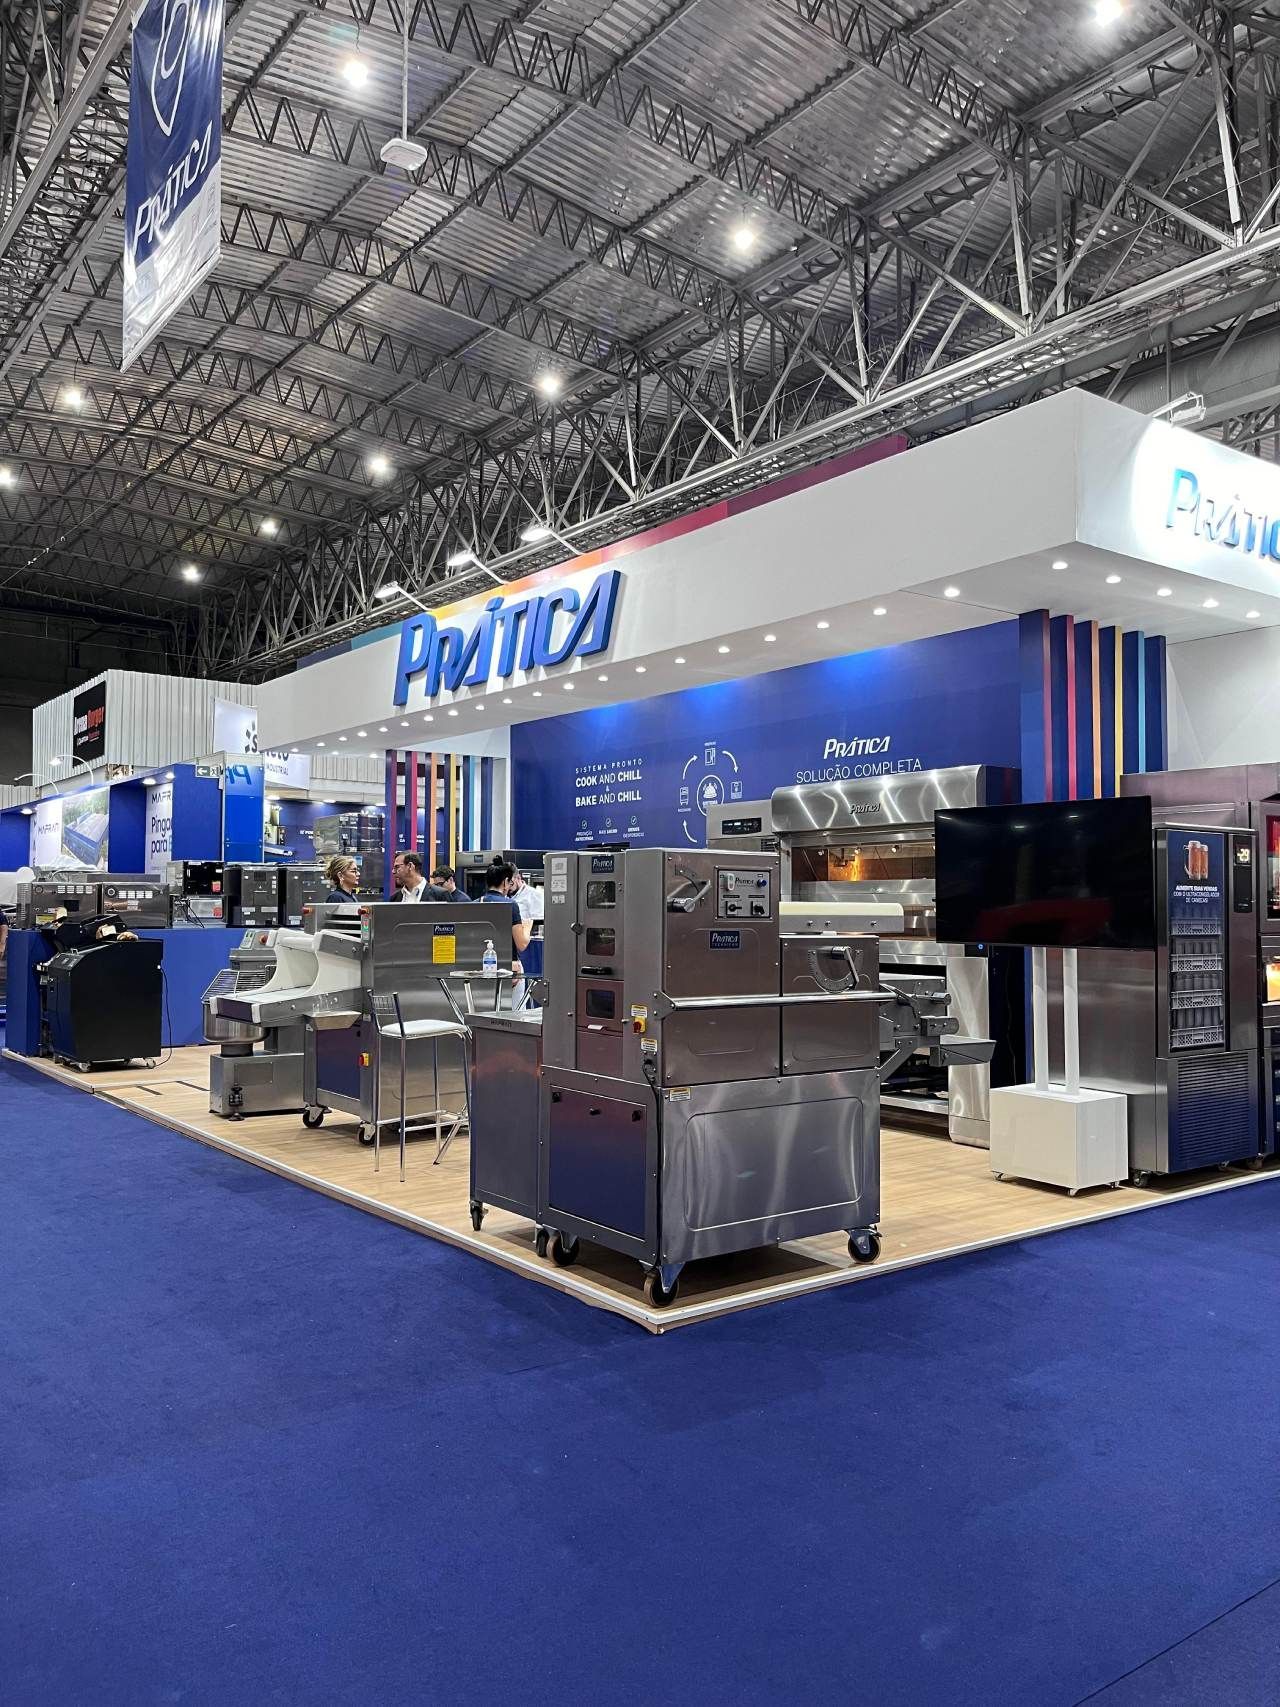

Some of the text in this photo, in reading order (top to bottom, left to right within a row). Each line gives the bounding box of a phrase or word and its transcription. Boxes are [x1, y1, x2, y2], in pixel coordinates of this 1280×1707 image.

[393, 570, 622, 706] PRÁTICA
[823, 736, 890, 759] PRÁTICA
[575, 763, 607, 774] SISTEMA
[575, 769, 642, 787] COOK AND CHILL
[796, 758, 922, 784] SOLUÇÃO COMPLETA
[575, 790, 642, 807] BAKE AND CHILL
[151, 840, 167, 860] para
